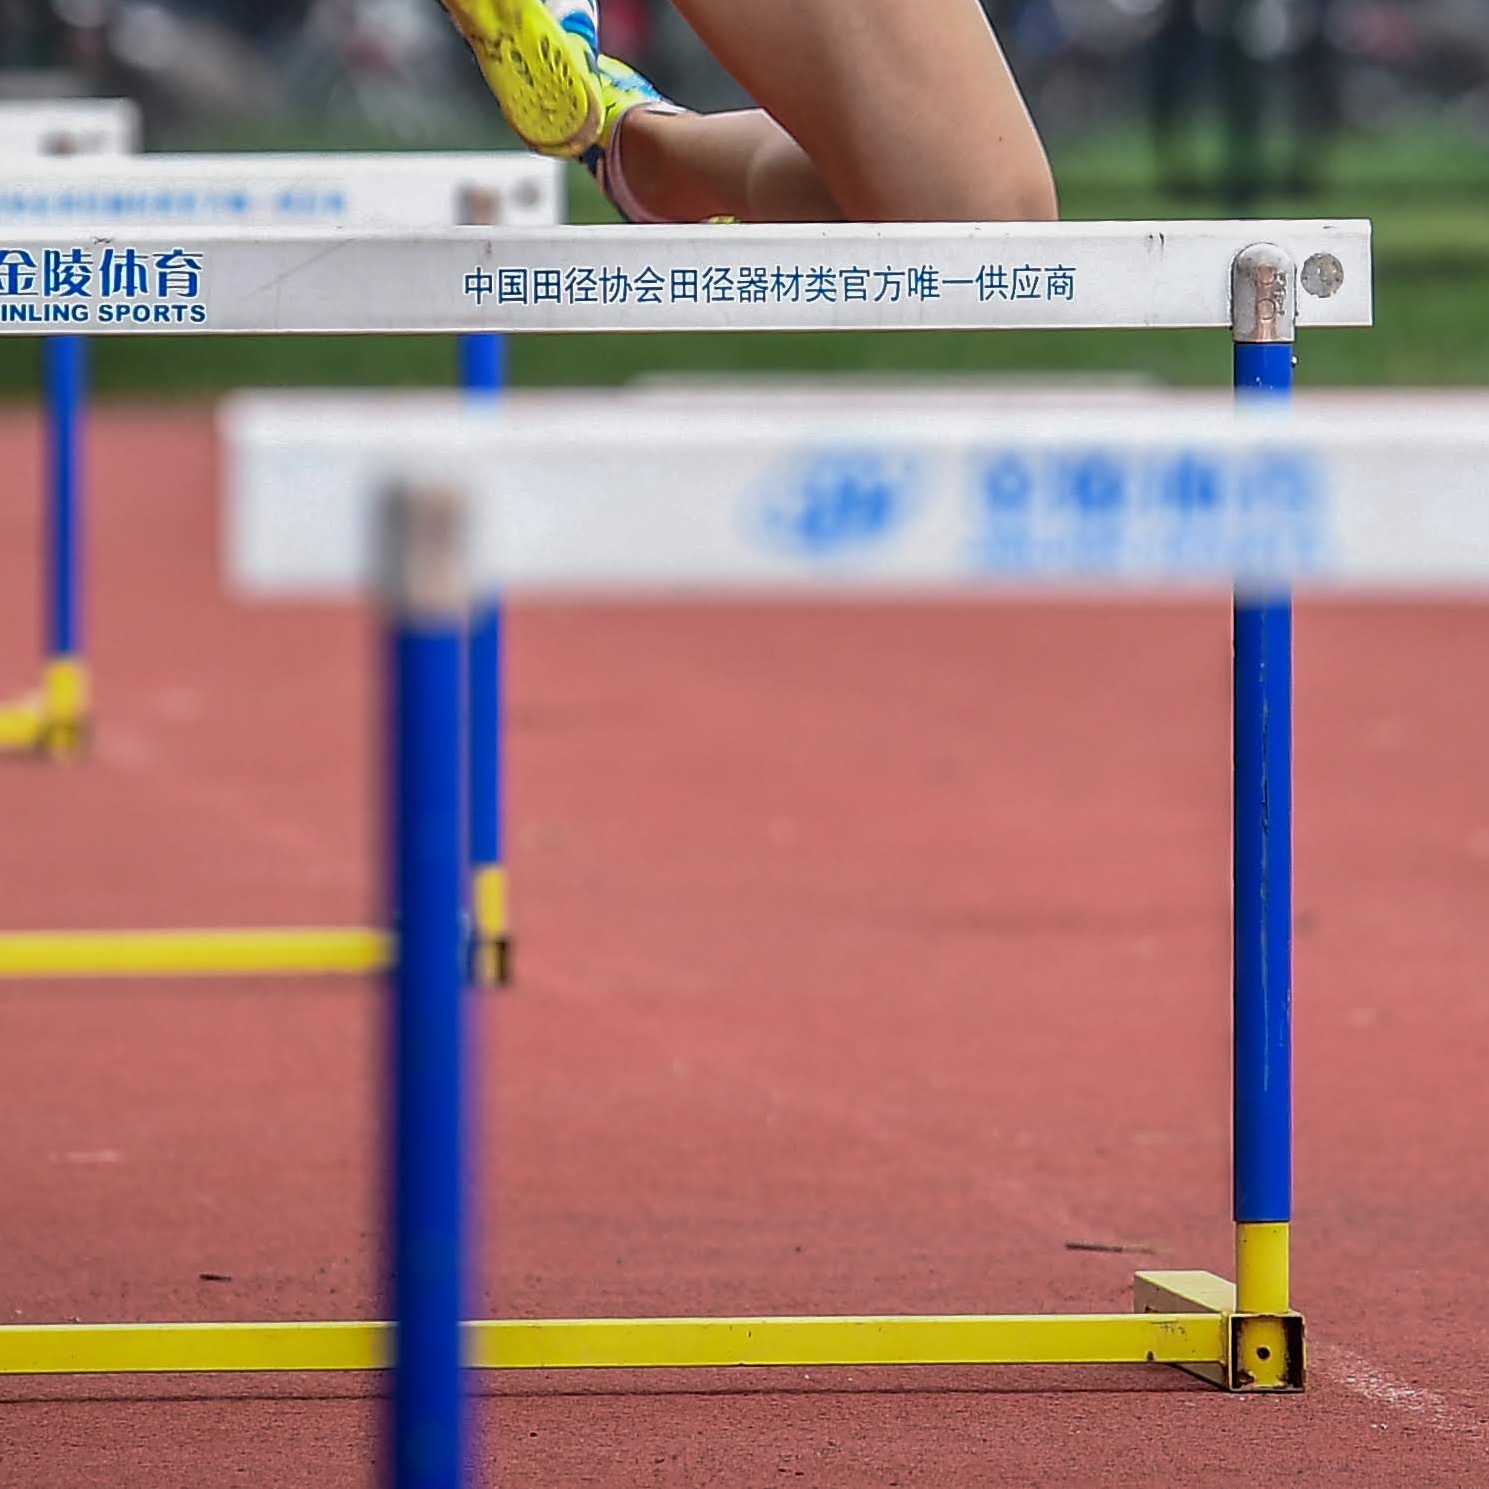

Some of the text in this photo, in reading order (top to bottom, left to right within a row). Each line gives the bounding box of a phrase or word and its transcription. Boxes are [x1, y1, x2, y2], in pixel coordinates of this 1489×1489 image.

[464, 264, 1076, 305] 中国田径协会田径器材类官方唯一供应商
[98, 303, 206, 323] SPORTS
